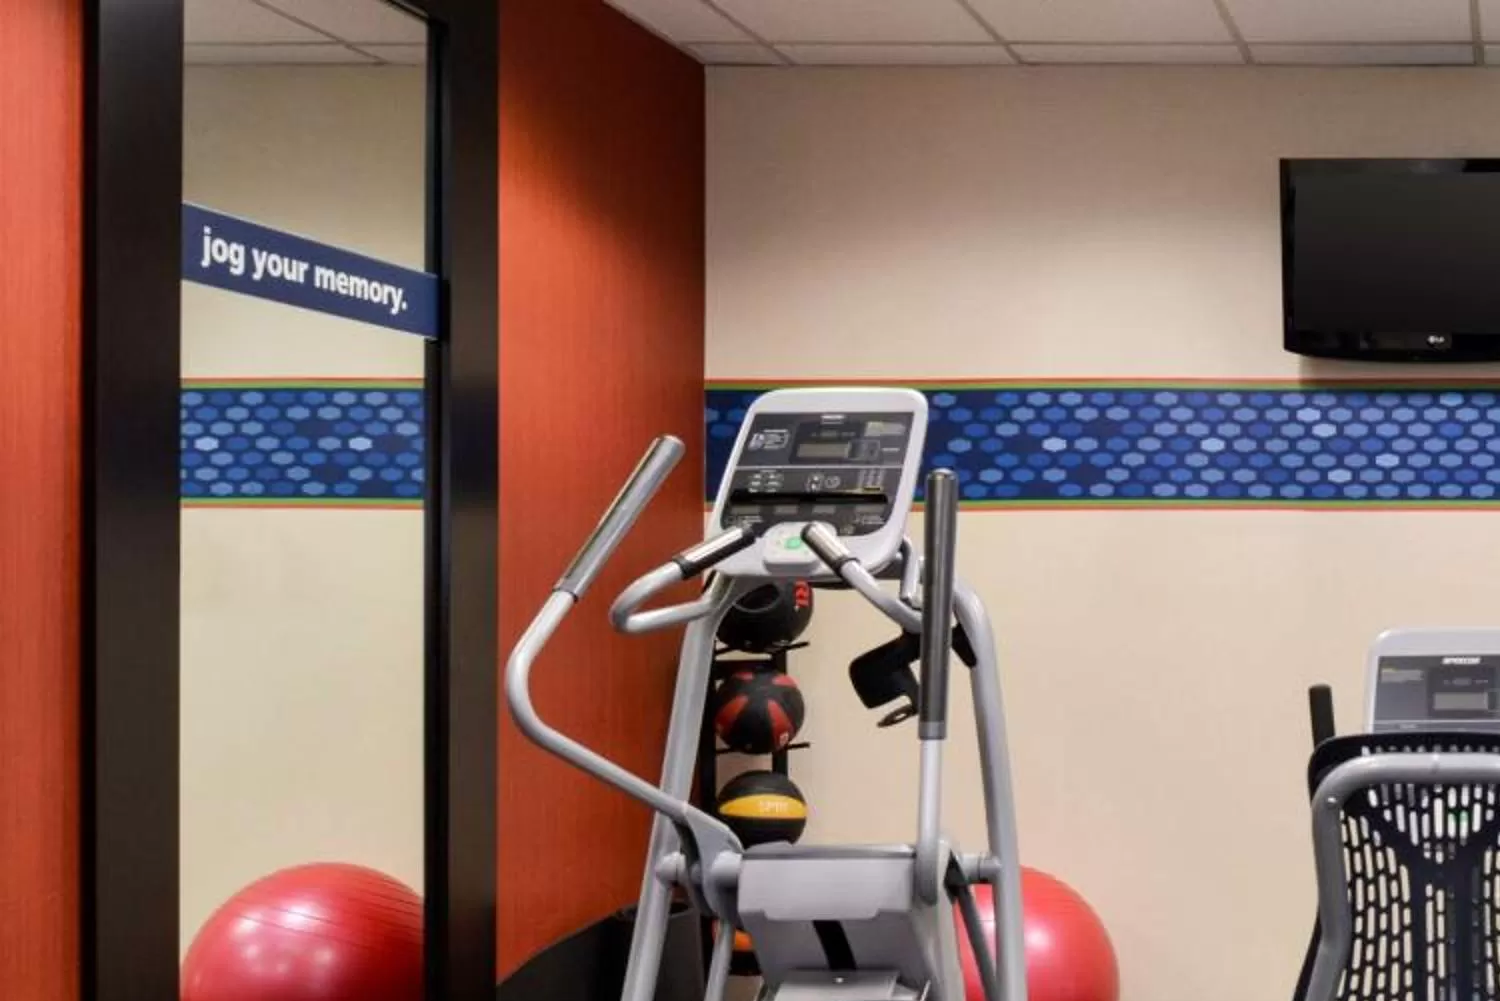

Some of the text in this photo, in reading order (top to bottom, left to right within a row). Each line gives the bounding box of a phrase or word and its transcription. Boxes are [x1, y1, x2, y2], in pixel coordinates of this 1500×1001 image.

[200, 225, 408, 315] jog your memory.
